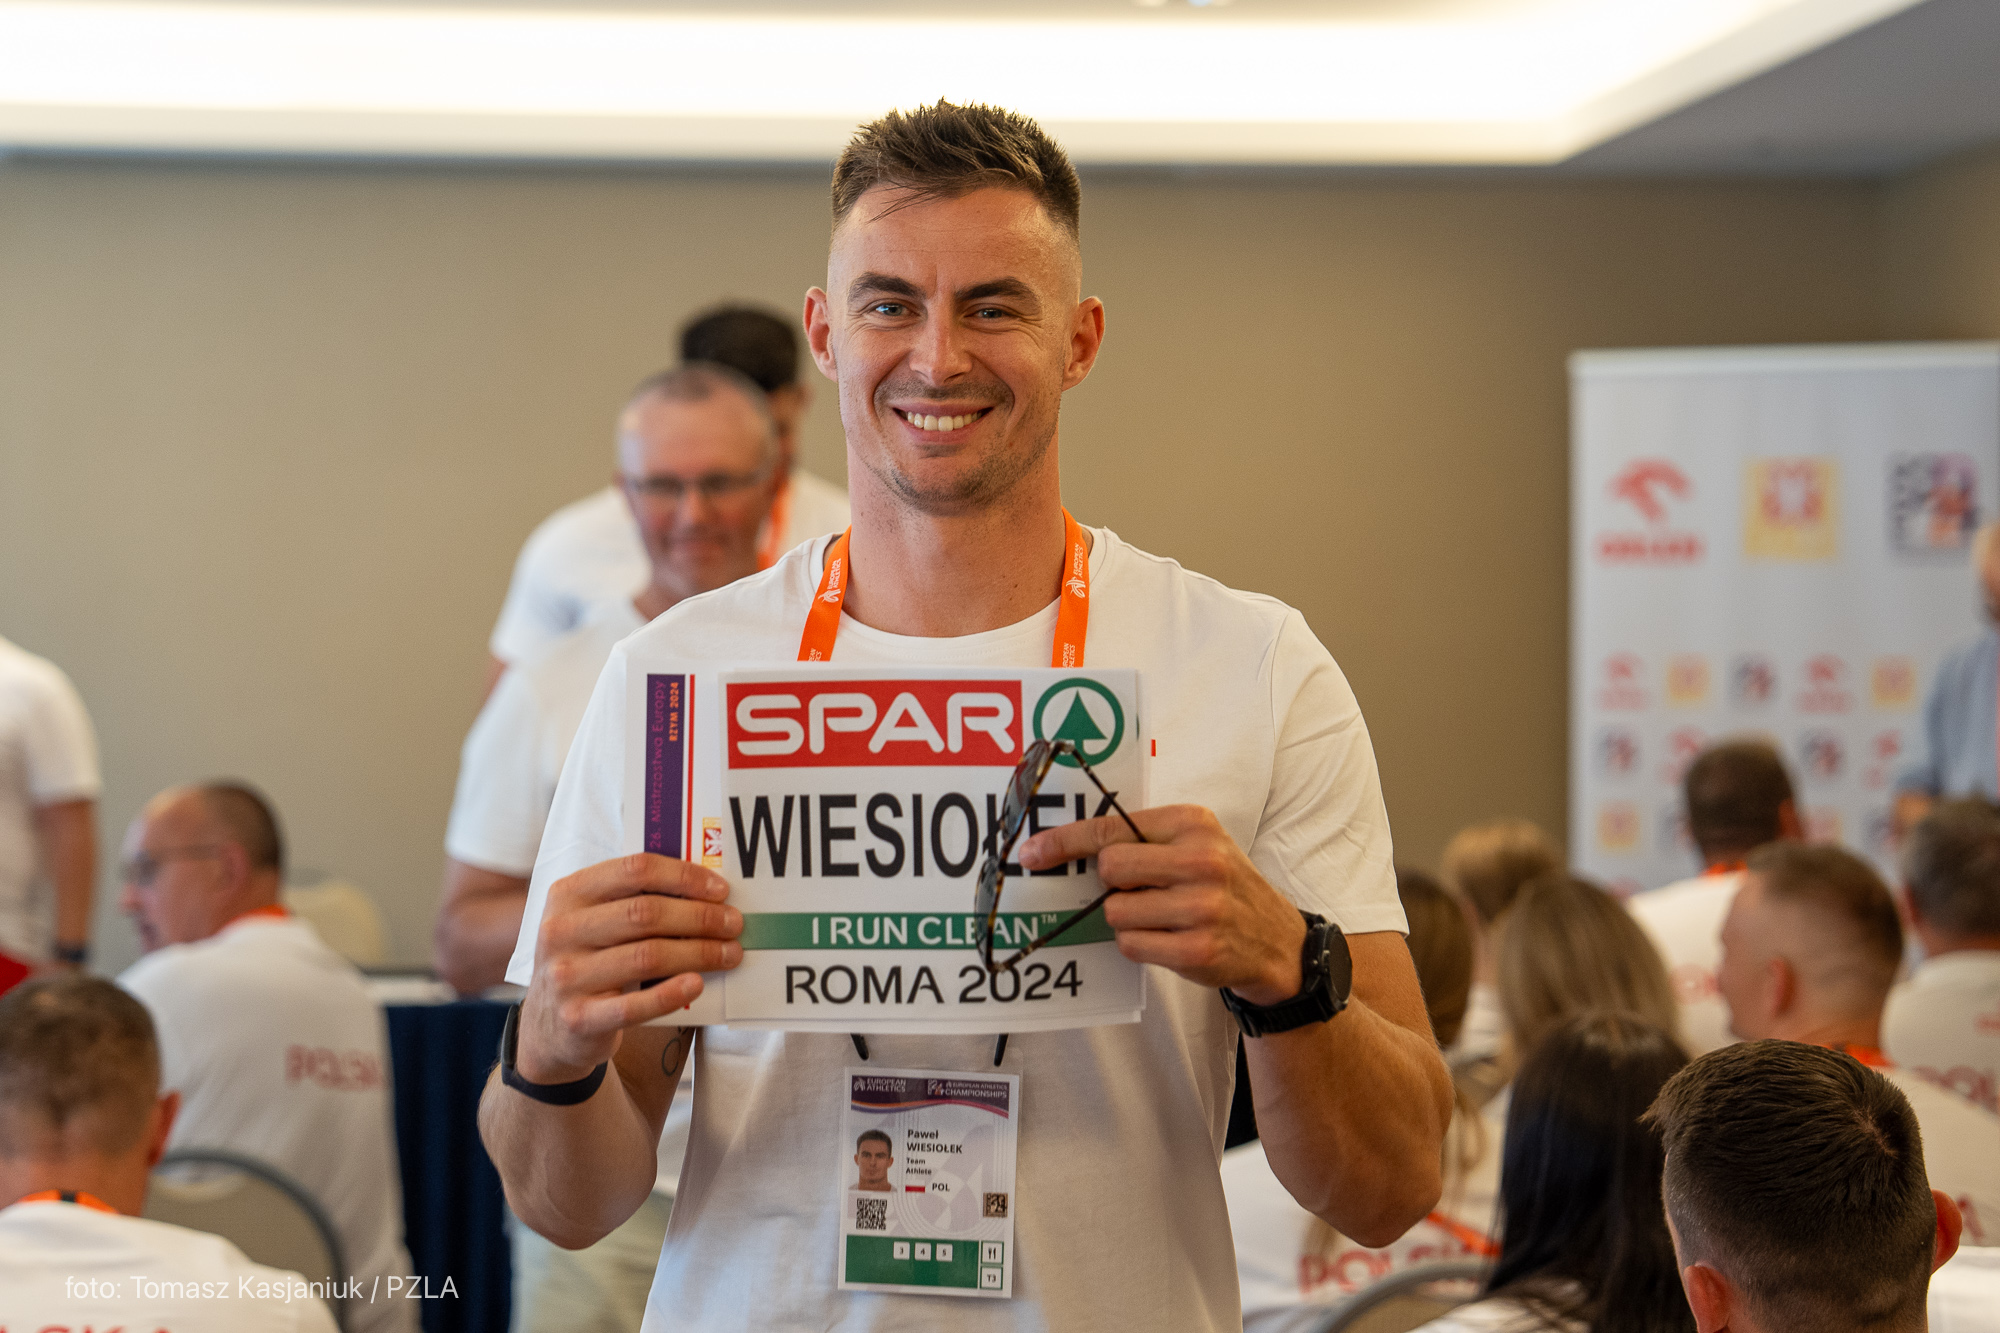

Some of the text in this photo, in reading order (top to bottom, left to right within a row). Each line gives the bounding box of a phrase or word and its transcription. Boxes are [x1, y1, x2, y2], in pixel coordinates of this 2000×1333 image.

[652, 681, 666, 732] Europy
[669, 682, 679, 742] RZYM 2024
[736, 692, 1015, 755] SPAR
[651, 736, 664, 822] Mistrzostwa
[812, 917, 820, 945] I
[830, 916, 908, 945] RUN
[786, 960, 1084, 1004] ROMA 2024
[866, 1078, 907, 1087] EUROPEAN
[866, 1084, 906, 1093] ATHLETICS
[945, 1088, 1008, 1099] CHAMPIONSHIPS
[905, 1167, 932, 1175] Athlete
[906, 1157, 926, 1165] Team
[932, 1182, 951, 1192] POL
